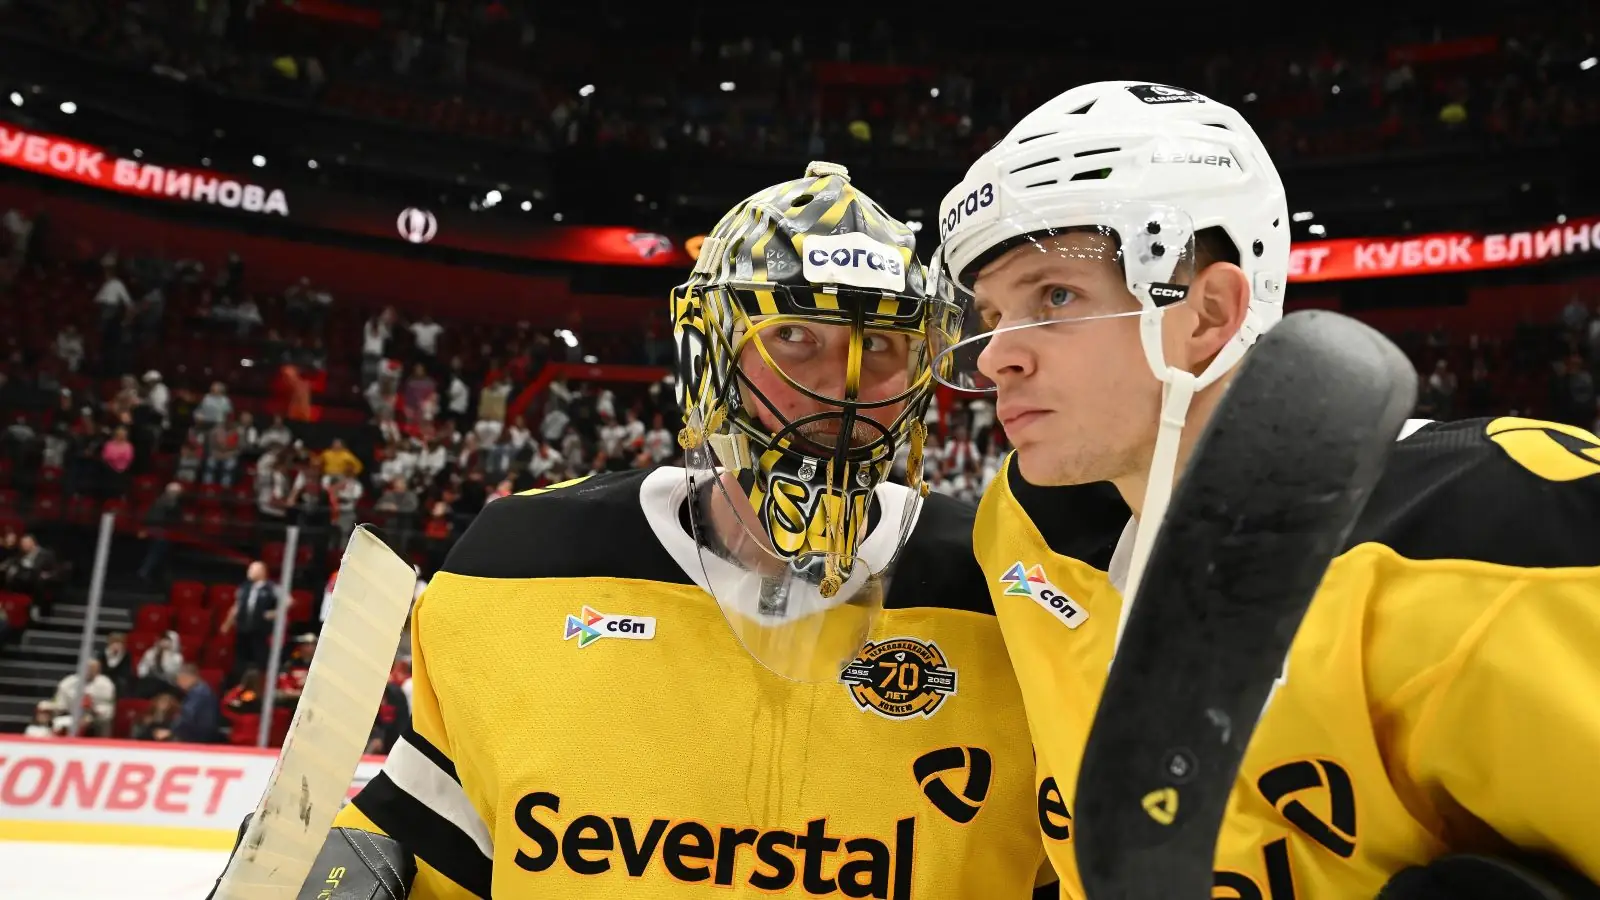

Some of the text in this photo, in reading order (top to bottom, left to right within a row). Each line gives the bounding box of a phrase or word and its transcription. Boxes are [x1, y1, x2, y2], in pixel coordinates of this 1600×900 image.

[0, 127, 289, 217] УБОК БЛИНОВА
[1352, 236, 1475, 271] КУБОК
[1151, 287, 1185, 299] CCM
[606, 618, 645, 634] сбп
[878, 661, 919, 691] 70
[884, 690, 909, 701] ЛЕТ
[0, 757, 245, 815] ONBET
[513, 791, 917, 900] Severstal
